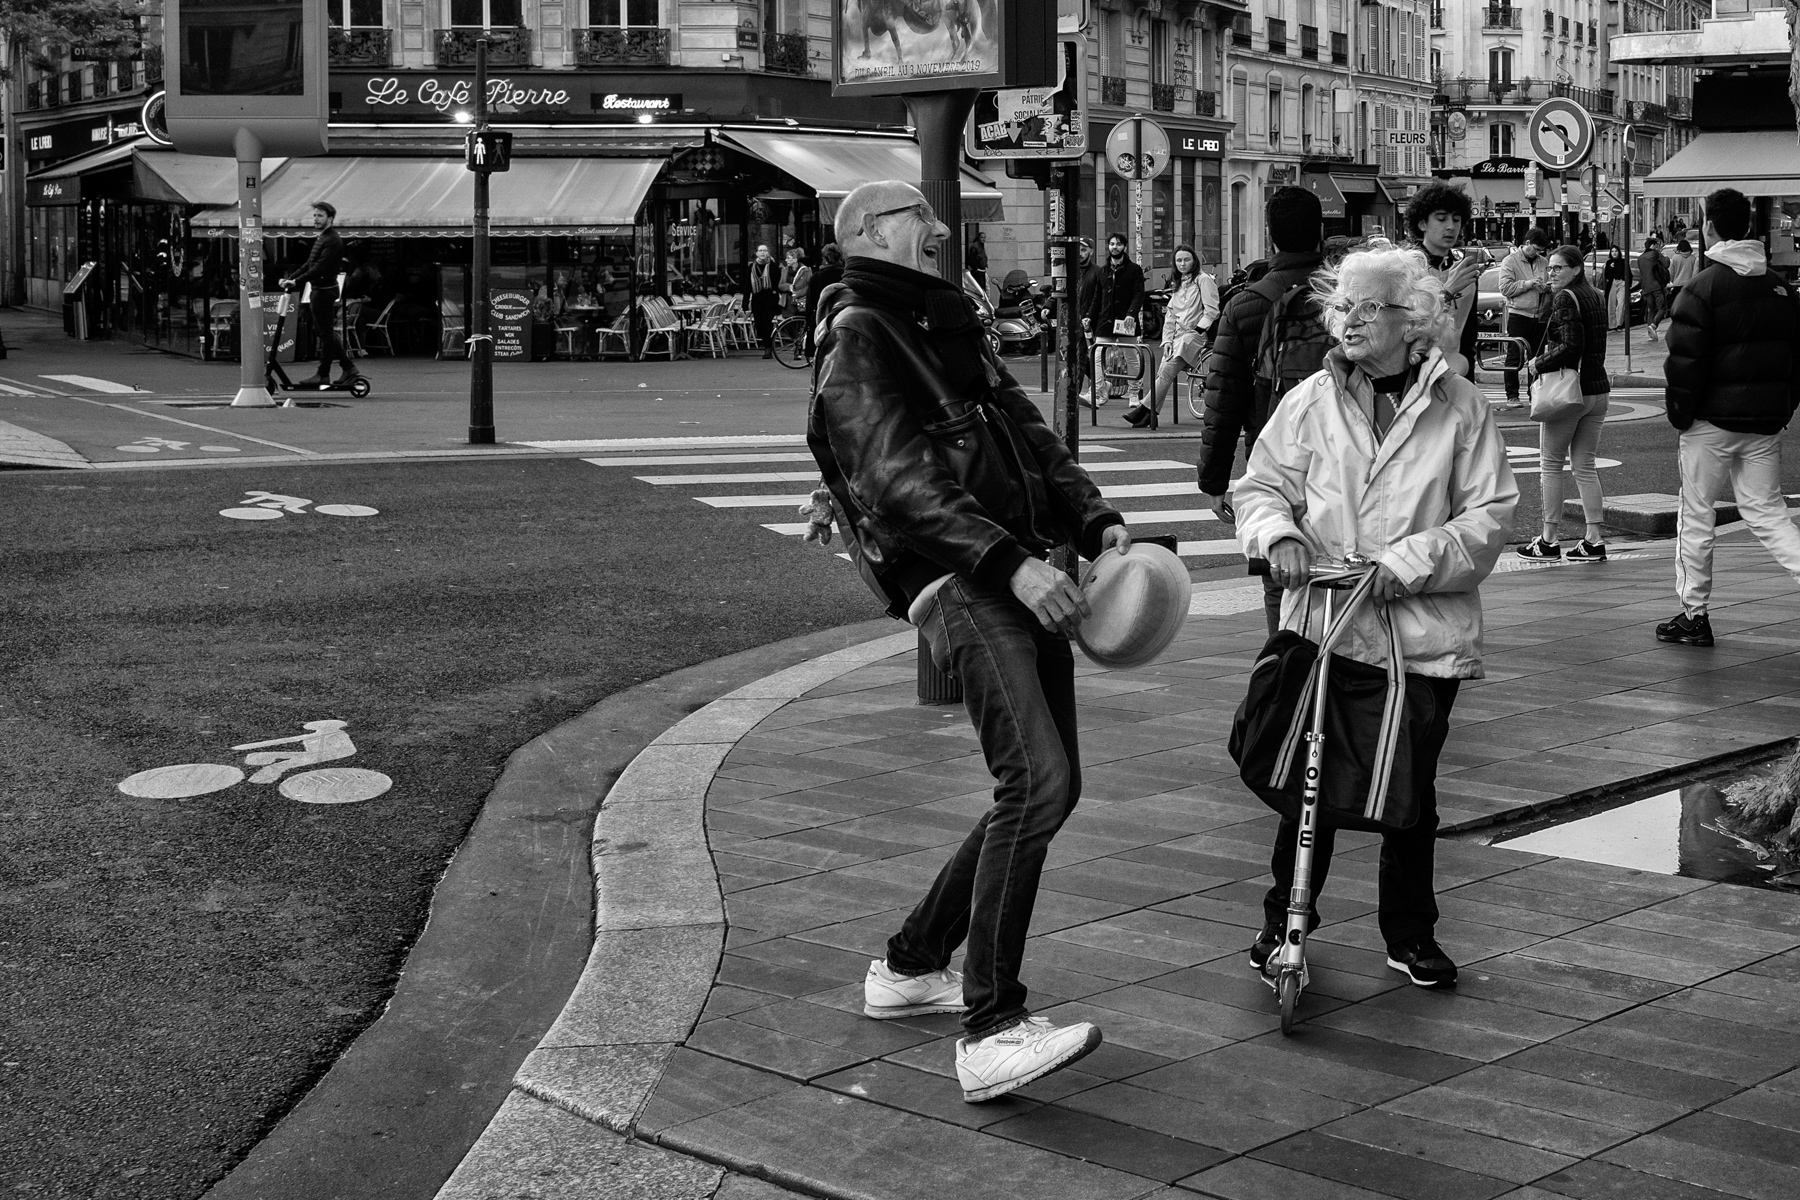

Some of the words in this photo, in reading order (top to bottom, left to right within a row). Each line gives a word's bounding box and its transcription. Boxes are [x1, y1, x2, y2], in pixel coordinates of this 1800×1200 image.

[855, 68, 865, 78] DU
[873, 66, 895, 77] AVRIL
[898, 65, 908, 76] AU
[909, 65, 914, 75] 3
[916, 62, 960, 75] NOVEMBRE
[961, 60, 981, 71] 2019
[366, 78, 409, 105] Le
[417, 79, 472, 112] Café
[486, 79, 570, 105] Pierre
[603, 94, 670, 109] Restaurant
[980, 123, 1008, 140] ACAB
[1389, 132, 1426, 144] FLEURS
[31, 137, 38, 150] LE
[1183, 138, 1194, 150] LE
[1198, 139, 1219, 151] LABO
[1480, 162, 1496, 173] La
[671, 222, 697, 237] SERVICE
[491, 293, 530, 306] CHEESEBURGER
[491, 309, 504, 320] CLUB
[505, 309, 530, 321] SANDWICH
[1299, 766, 1319, 848] micro
